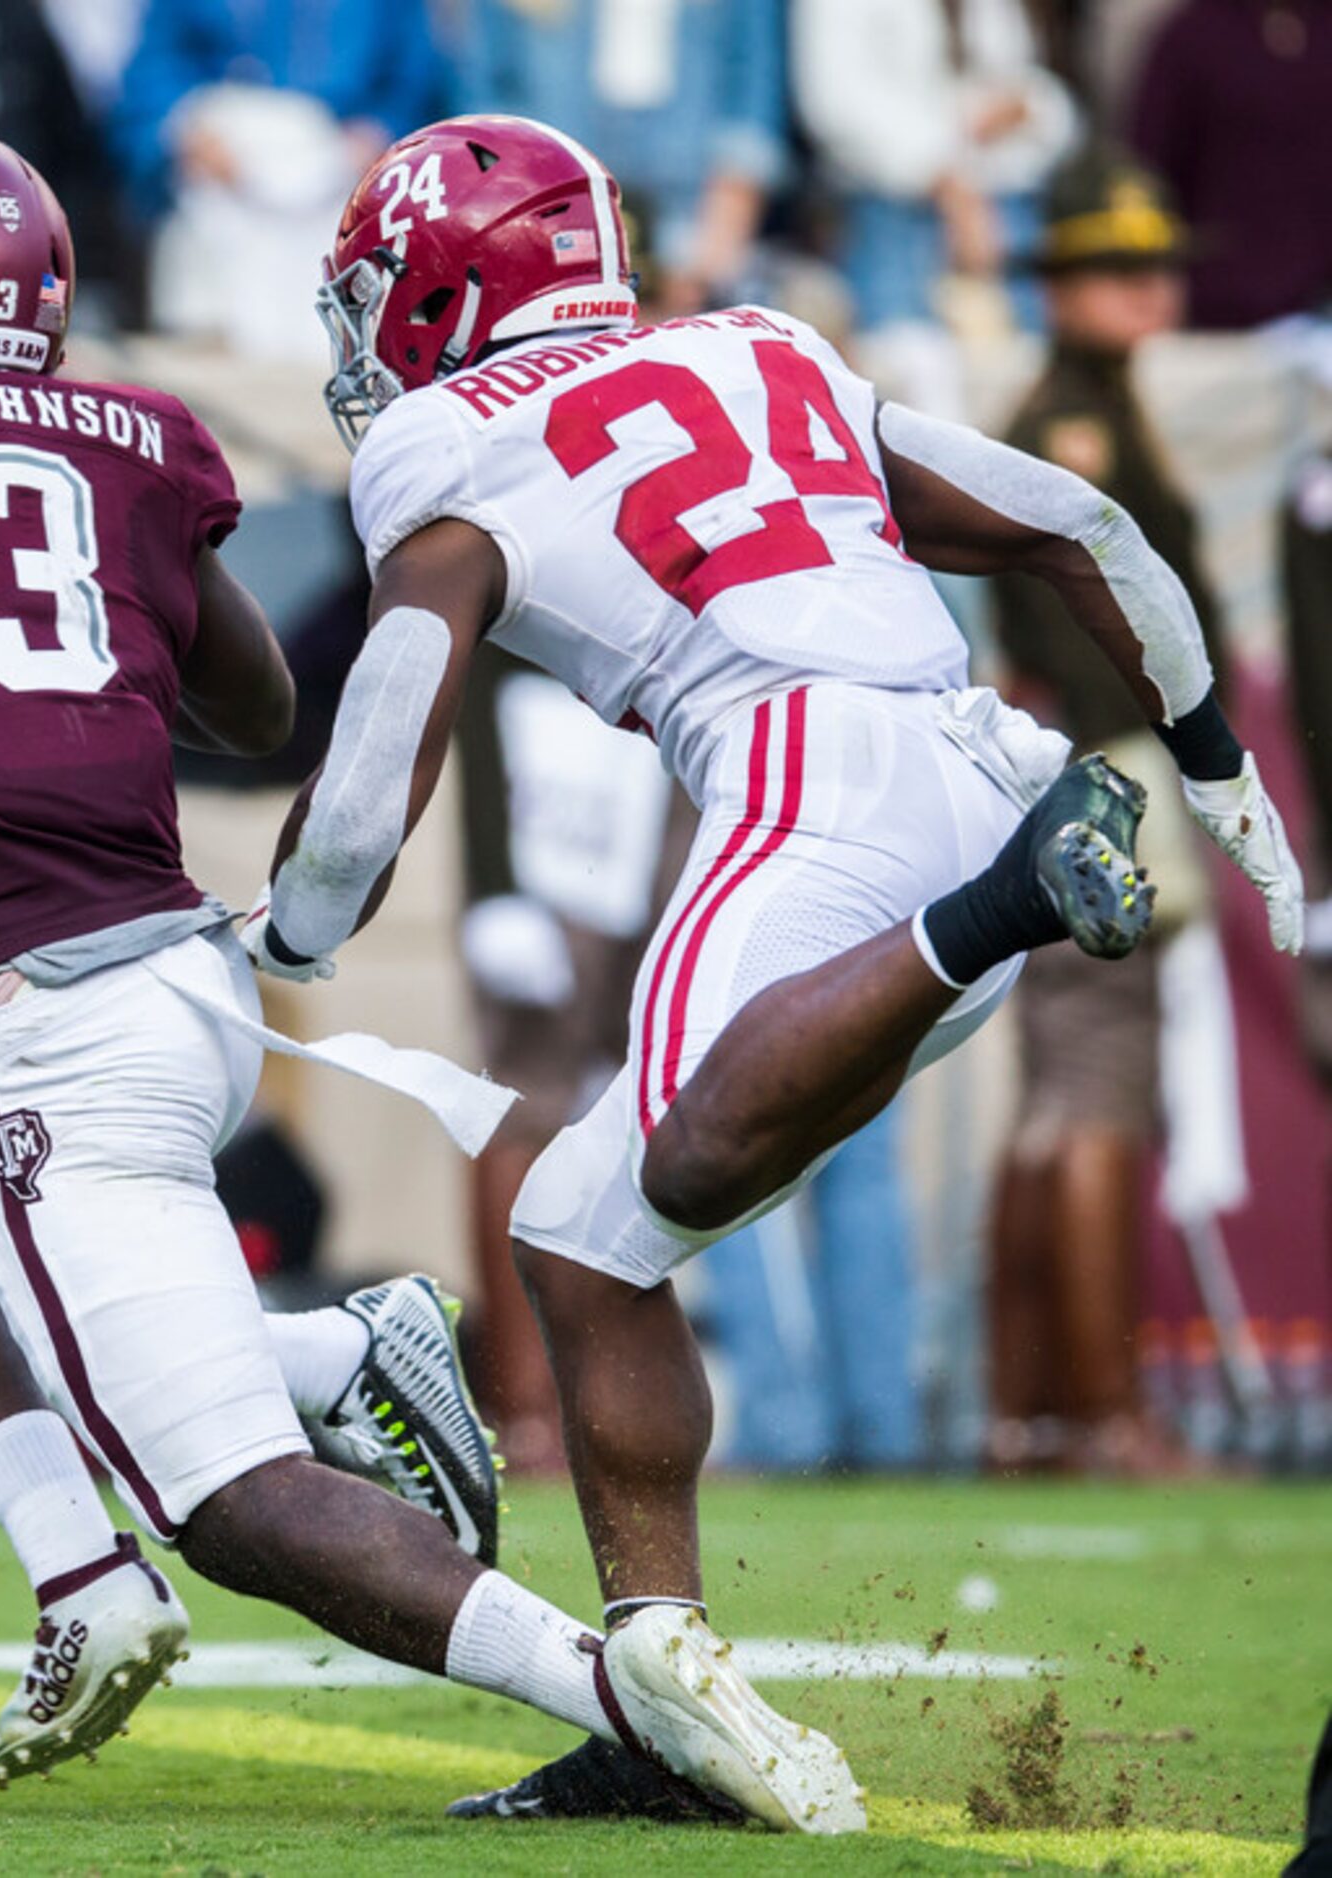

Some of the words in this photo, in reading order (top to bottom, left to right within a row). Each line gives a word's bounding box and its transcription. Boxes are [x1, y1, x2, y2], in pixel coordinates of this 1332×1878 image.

[379, 153, 448, 240] 24
[542, 339, 904, 620] 24
[28, 1619, 89, 1725] adidas
